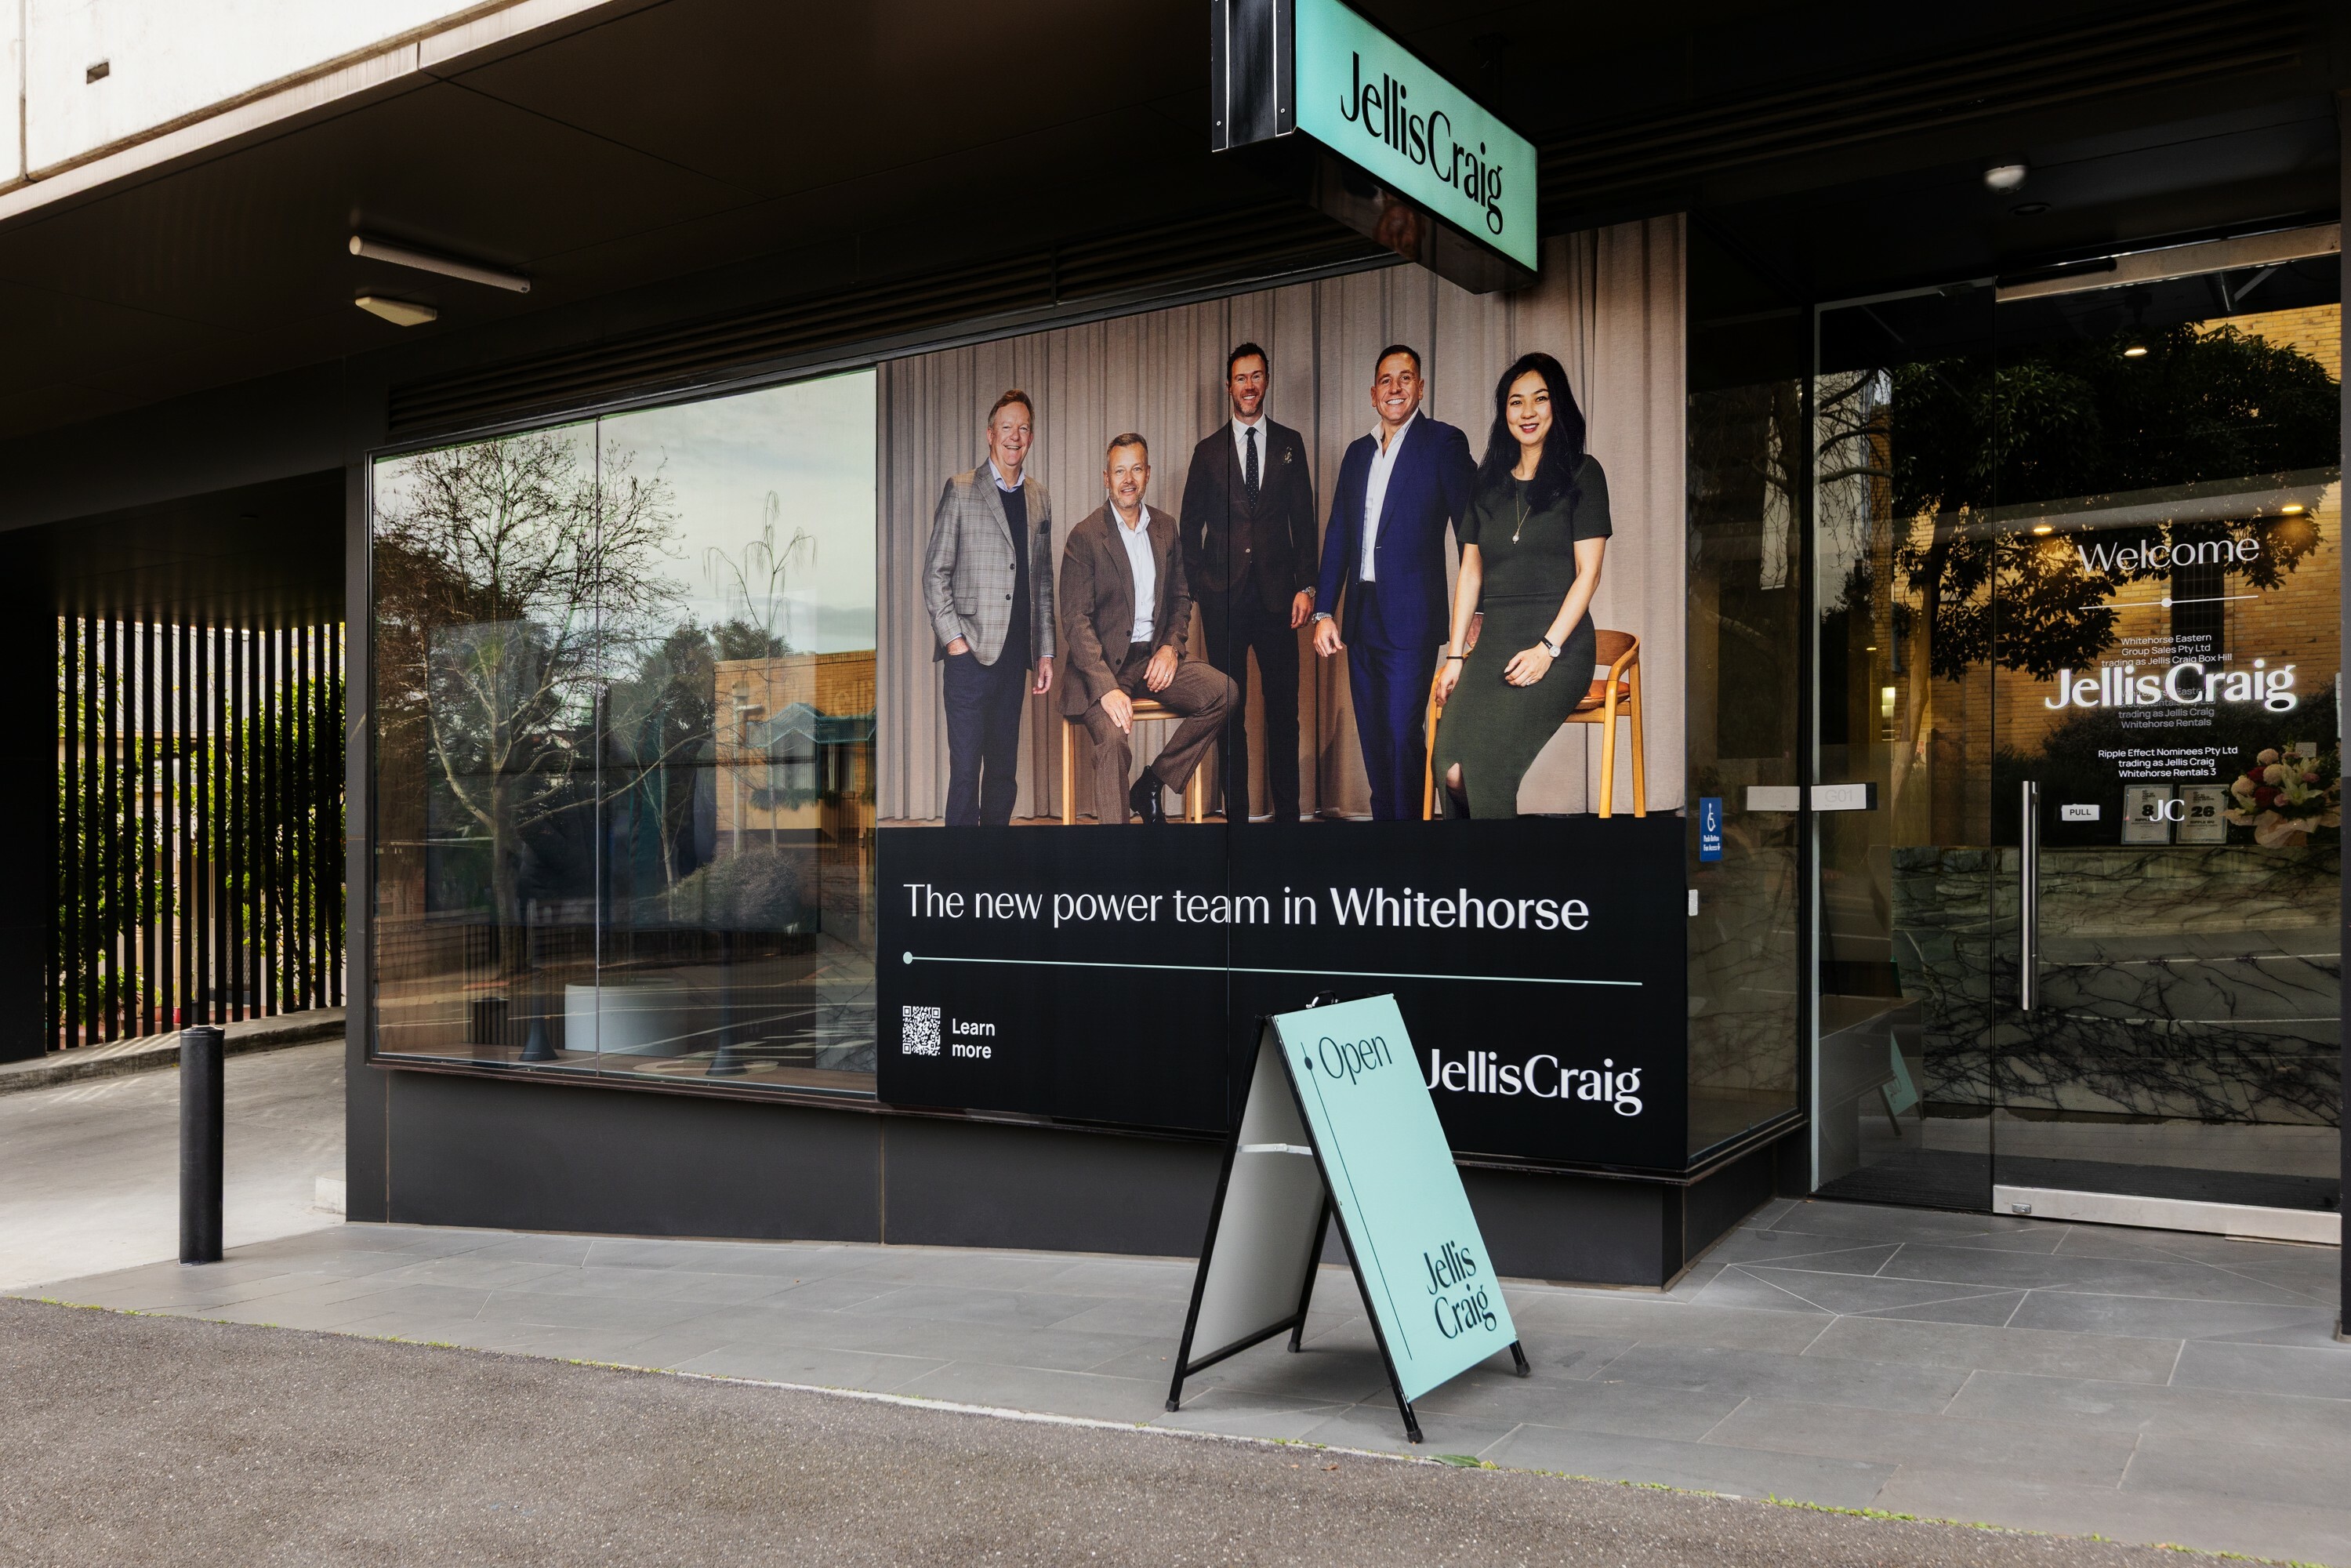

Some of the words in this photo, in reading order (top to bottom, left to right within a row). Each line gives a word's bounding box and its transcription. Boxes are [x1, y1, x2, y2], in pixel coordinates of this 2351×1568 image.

[1341, 50, 1504, 235] JellisCraig
[2077, 538, 2259, 572] Welcome
[2121, 635, 2174, 646] Whitehorse
[2175, 633, 2212, 643] Eastern
[2121, 647, 2150, 657] Group
[2151, 645, 2176, 655] Sales
[2178, 644, 2193, 654] Pty
[2195, 644, 2211, 652] Ltd
[2101, 659, 2134, 667] trading
[2148, 656, 2171, 665] Jellis
[2198, 654, 2216, 662] Box
[2044, 659, 2298, 712] JellisCraig
[2118, 710, 2151, 719] trading
[2164, 708, 2188, 717] Jellis
[2189, 707, 2215, 717] Craig
[2121, 720, 2175, 729] Whitehorse
[2176, 718, 2211, 727] Rentals
[2098, 750, 2126, 759] Ripple
[2128, 748, 2155, 757] Effect
[2157, 747, 2204, 756] Nominees
[2204, 747, 2221, 757] Pty
[2118, 759, 2151, 768] trading
[2189, 757, 2215, 767] Craig
[2118, 769, 2171, 778] Whitehorse
[2173, 768, 2209, 777] Rentals
[2211, 768, 2217, 776] 3
[1824, 789, 1852, 803] G01
[2142, 804, 2154, 816] 8
[2150, 799, 2185, 822] JC
[2190, 806, 2215, 817] 26
[903, 884, 964, 918] The
[975, 892, 1043, 920] new
[1054, 893, 1163, 928] power
[1172, 890, 1269, 924] team
[1284, 886, 1316, 925] in
[1330, 887, 1589, 931] Whitehorse
[952, 1018, 996, 1036] Learn
[952, 1044, 992, 1059] more
[1319, 1036, 1392, 1085] Open
[1427, 1048, 1642, 1116] JellisCraig
[1423, 1240, 1476, 1295] Jellis
[1434, 1283, 1497, 1339] Craig
